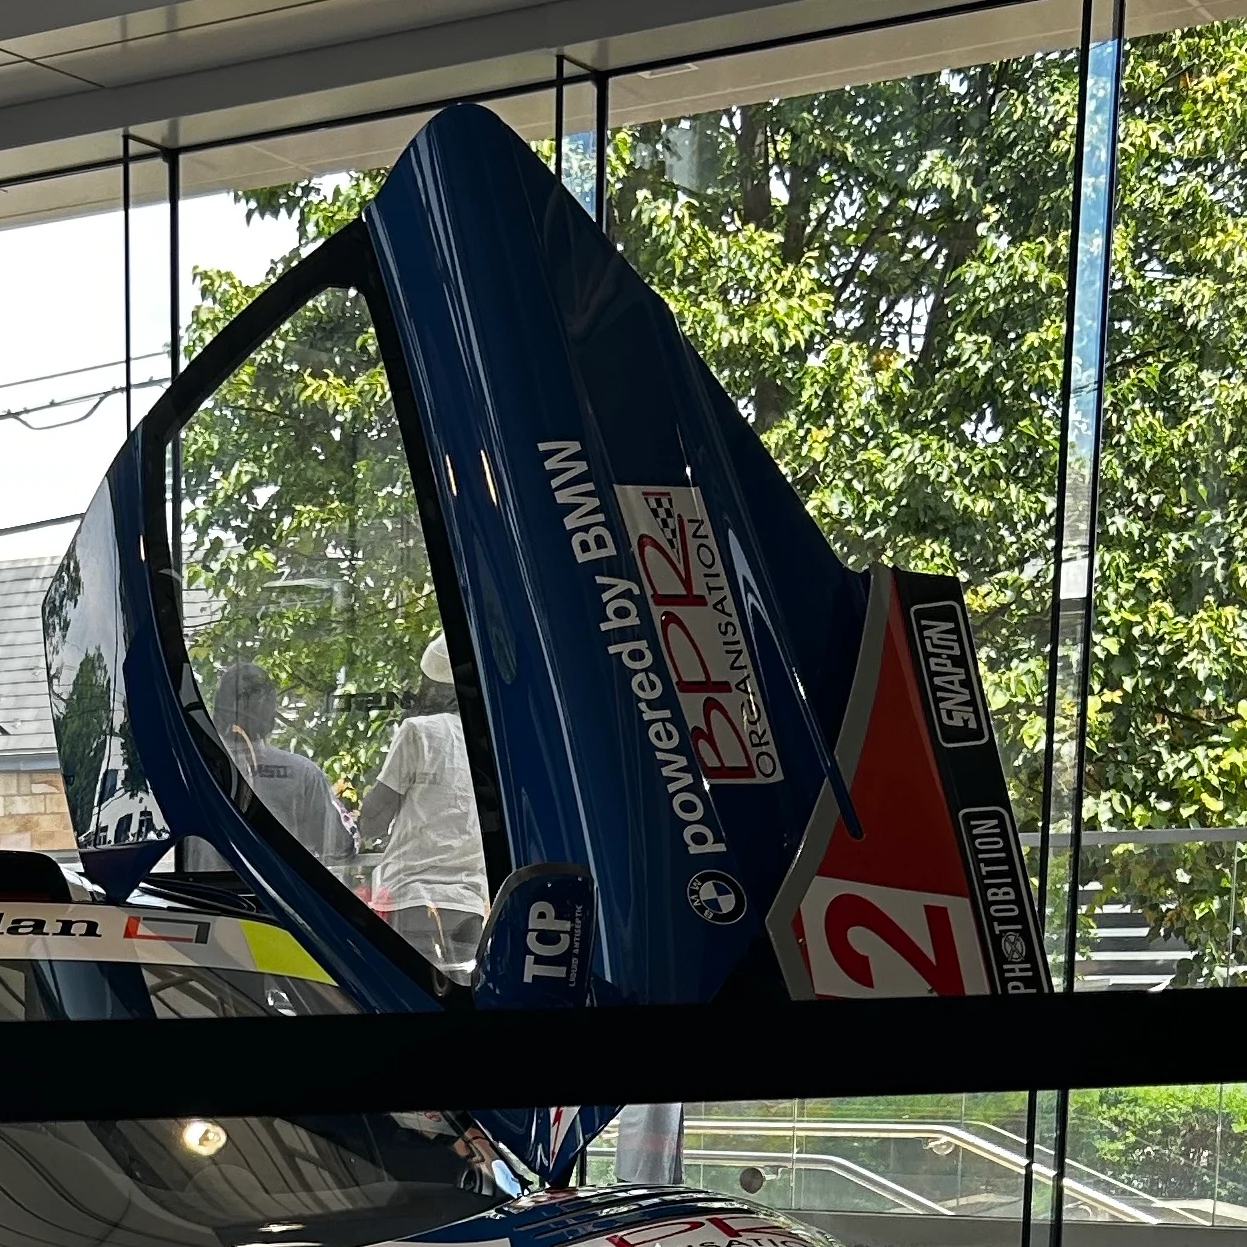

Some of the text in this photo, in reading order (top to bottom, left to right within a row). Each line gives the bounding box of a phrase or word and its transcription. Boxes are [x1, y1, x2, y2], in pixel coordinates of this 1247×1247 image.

[537, 440, 726, 855] powered by BMW
[637, 515, 756, 780] BPR
[688, 518, 778, 779] ORGANISATION
[523, 901, 571, 983] TCP
[690, 879, 714, 919] BMW
[824, 892, 966, 996] 2
[569, 957, 579, 987] LIQUID
